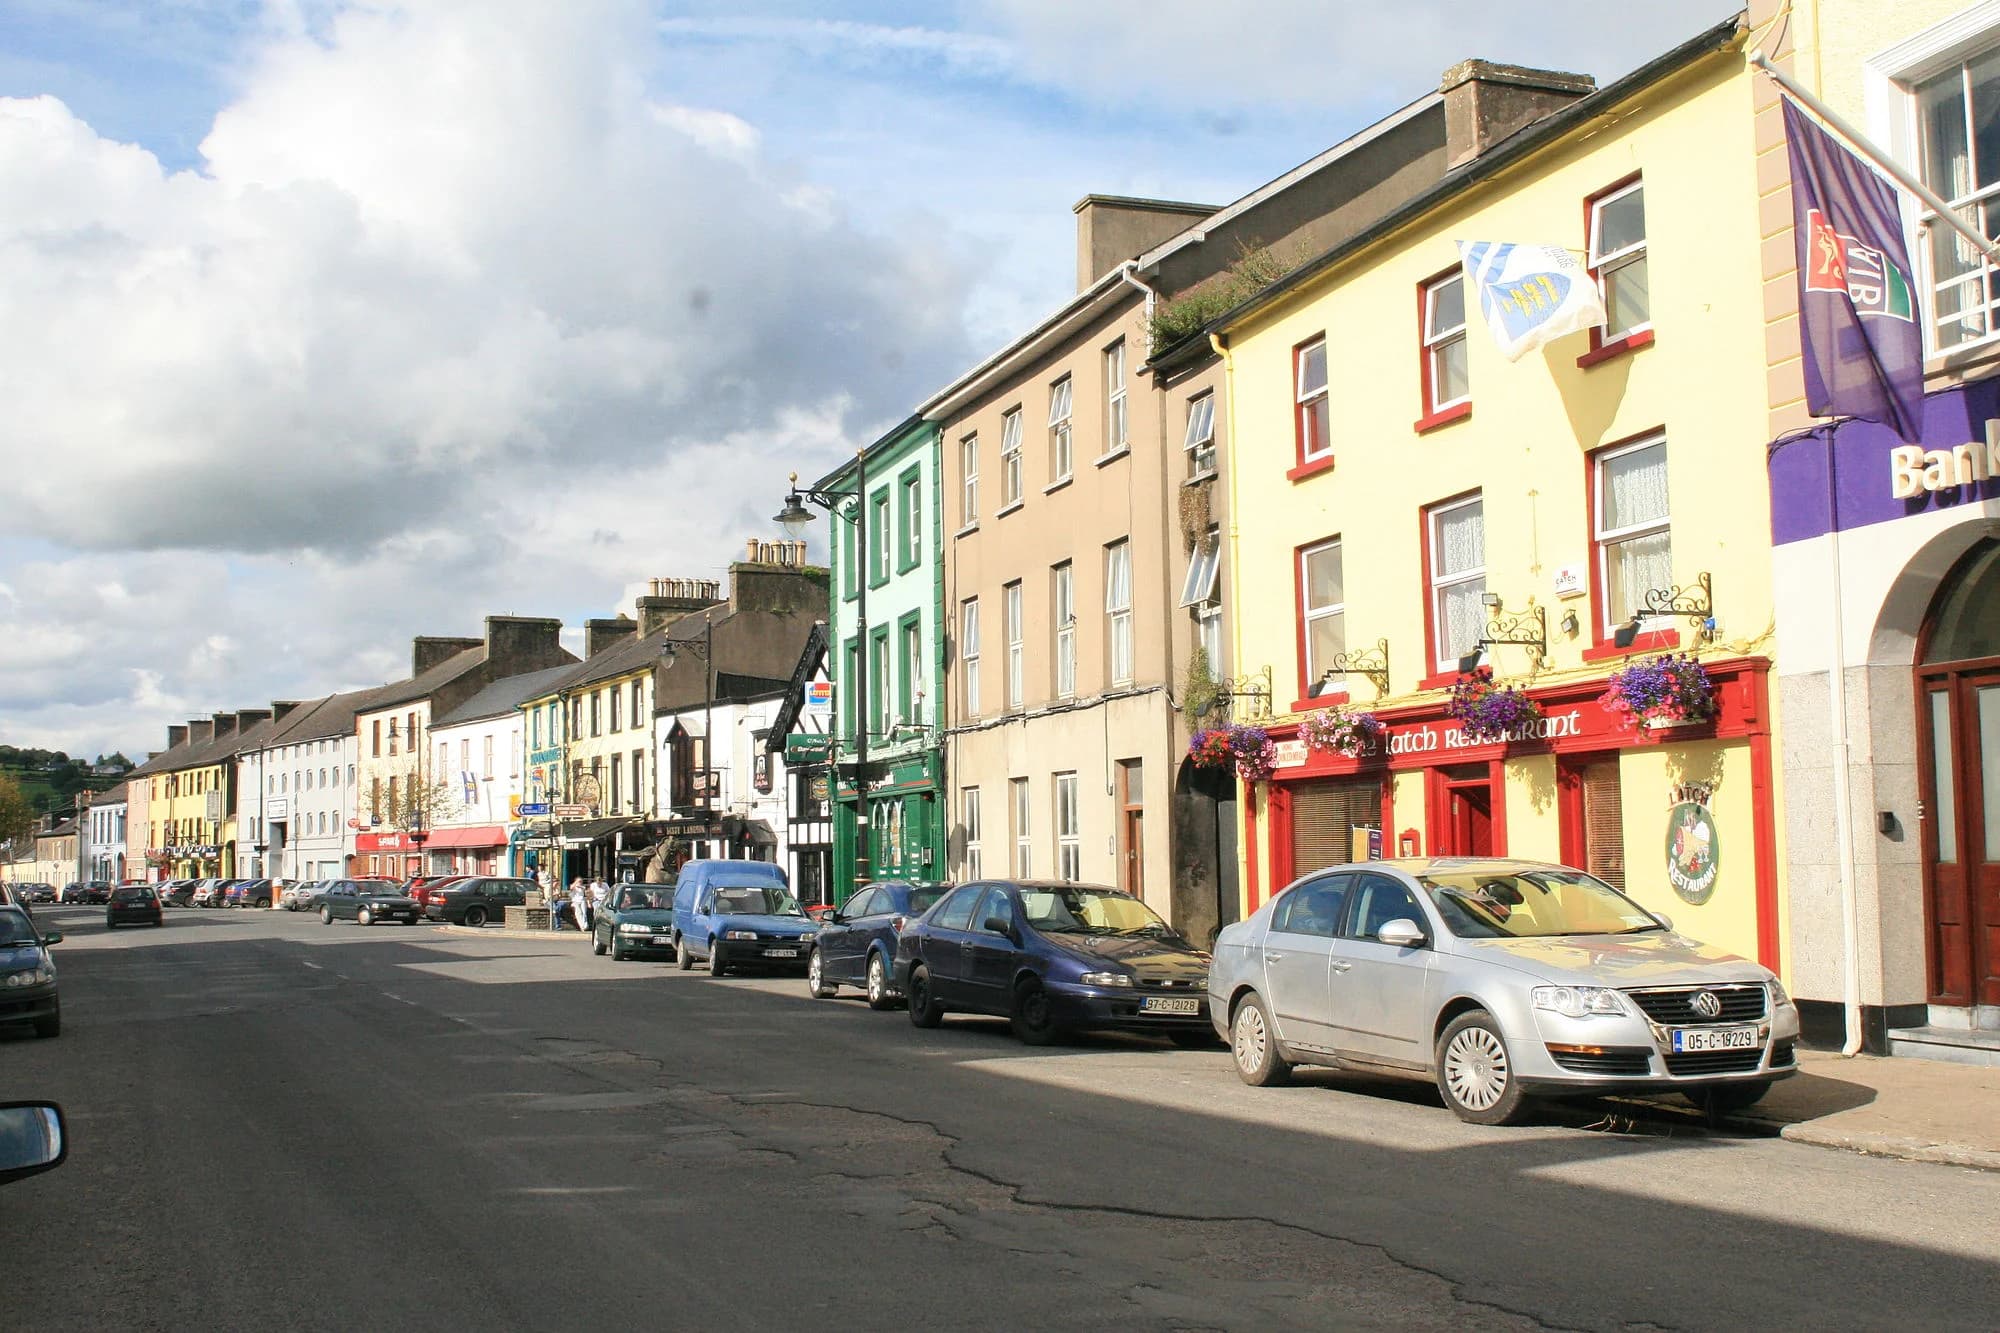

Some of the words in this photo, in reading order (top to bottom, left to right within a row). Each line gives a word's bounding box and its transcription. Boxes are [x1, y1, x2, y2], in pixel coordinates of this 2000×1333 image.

[1847, 247, 1881, 305] AIB
[1669, 786, 1709, 806] LATCH
[1669, 857, 1717, 892] RESTAURANT
